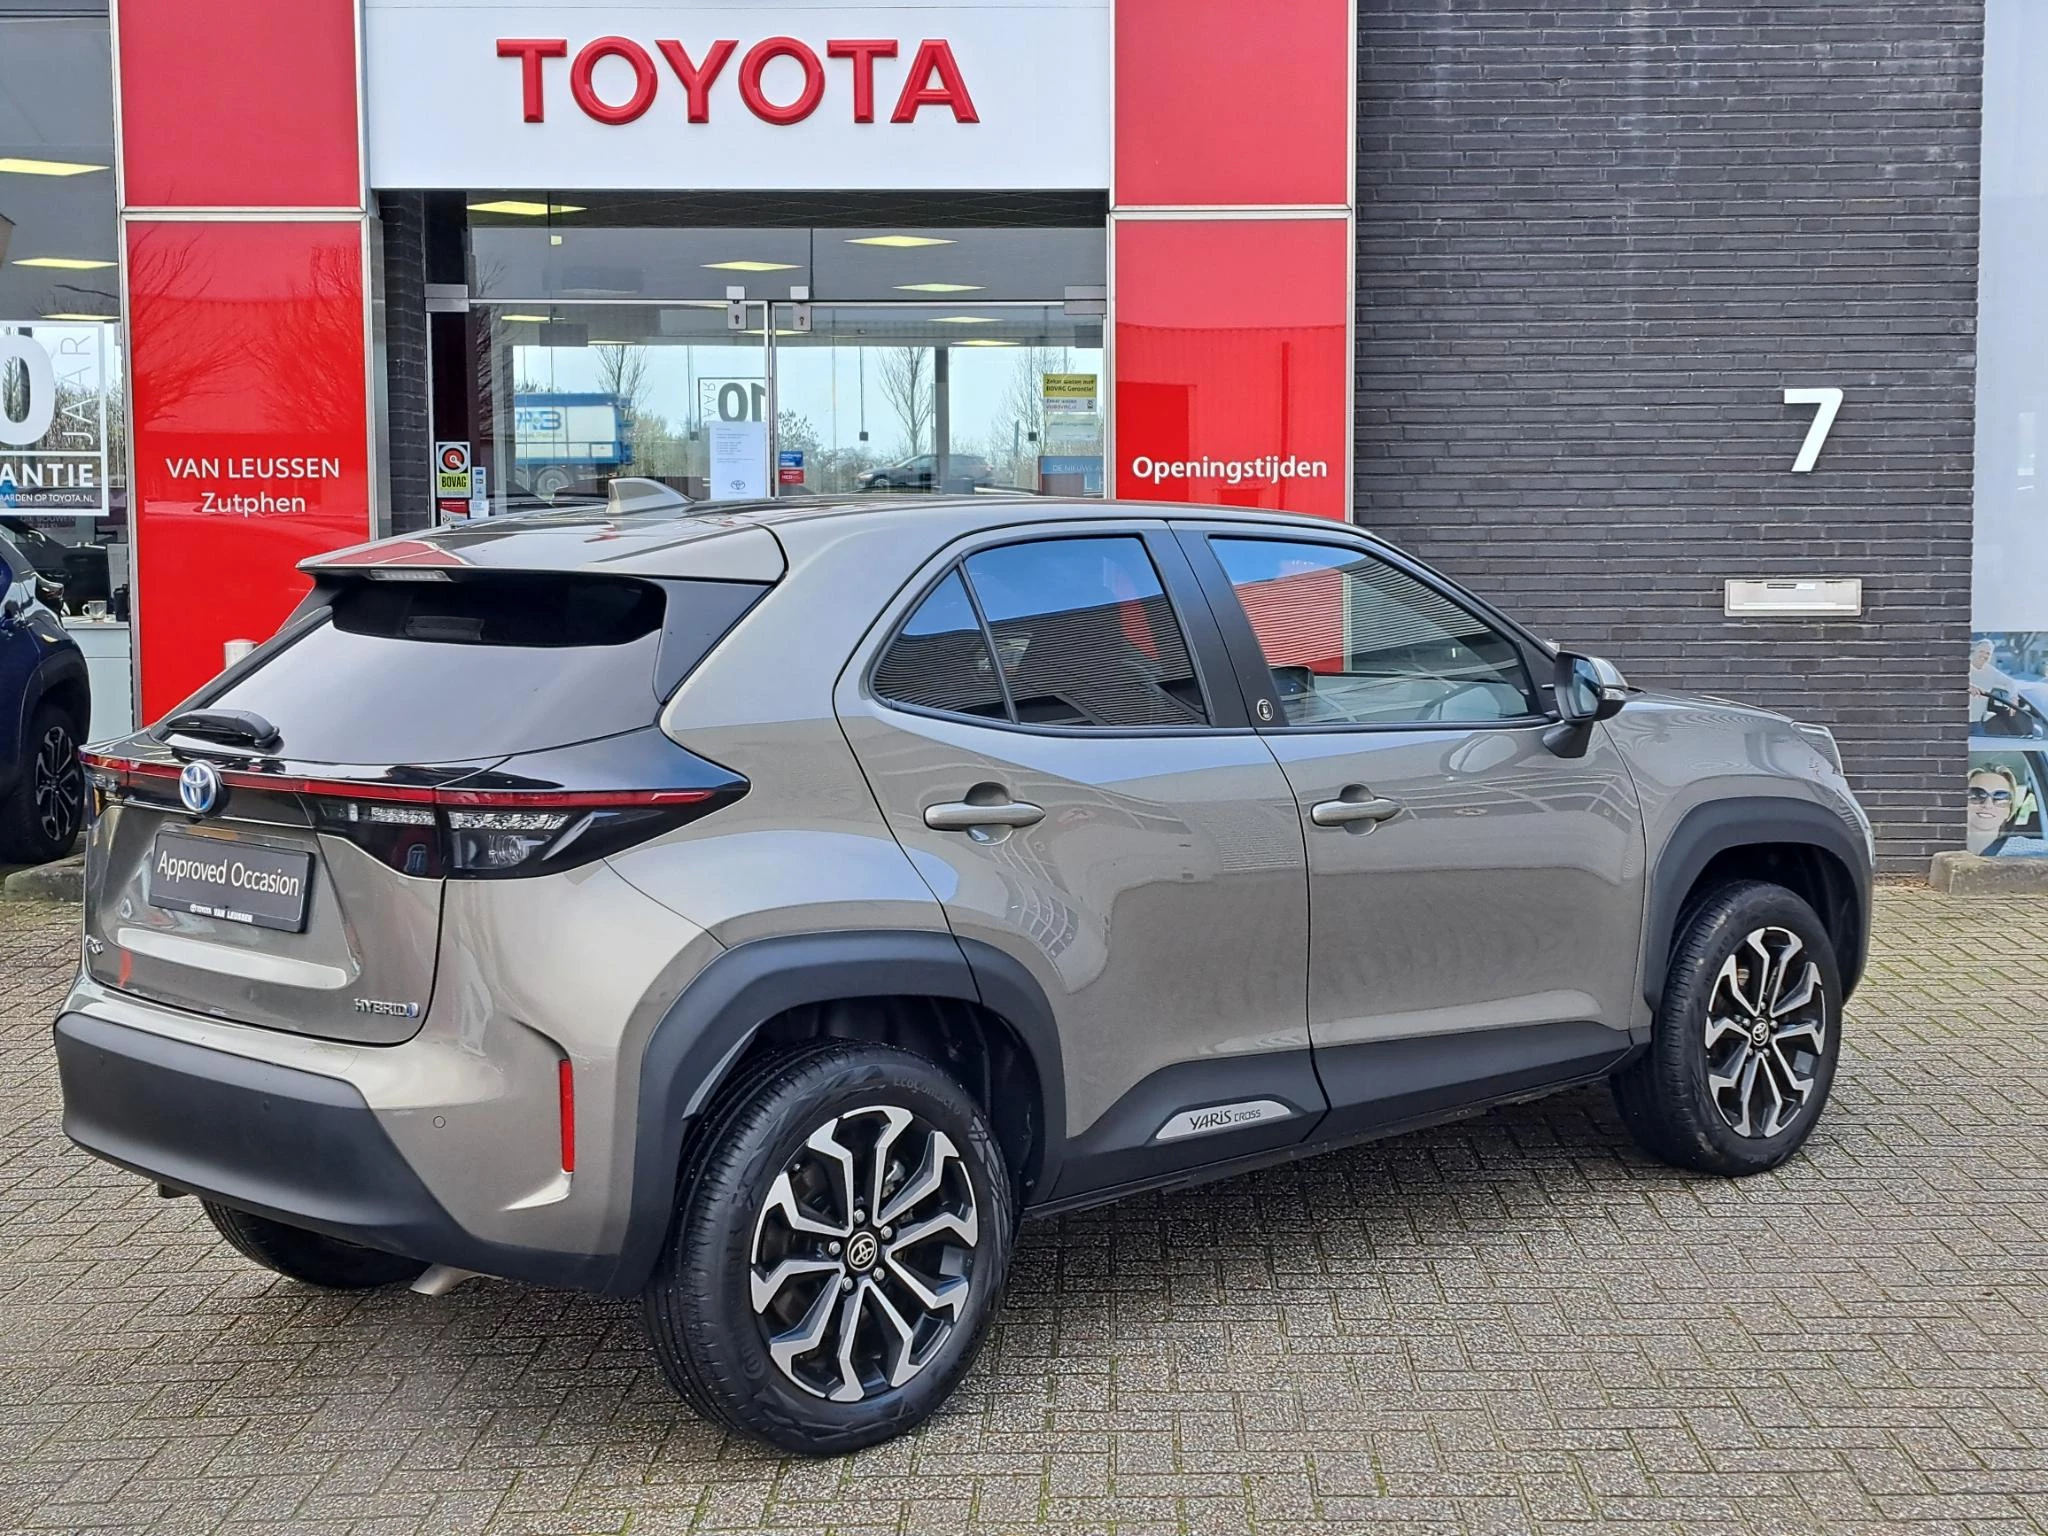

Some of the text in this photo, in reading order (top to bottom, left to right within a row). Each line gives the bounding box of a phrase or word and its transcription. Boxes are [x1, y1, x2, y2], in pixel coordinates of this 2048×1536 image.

[496, 36, 980, 125] TOYOTA
[60, 336, 94, 446] JAAR
[1784, 388, 1844, 472] 7
[165, 458, 340, 479] VAN LEUSSEN
[441, 476, 467, 488] BOVAG
[1132, 455, 1327, 485] Openingstijden
[201, 491, 306, 518] Zutphen
[157, 850, 300, 897] Approved Occasion
[353, 998, 407, 1017] HYBRID
[1234, 1108, 1262, 1123] CROSS
